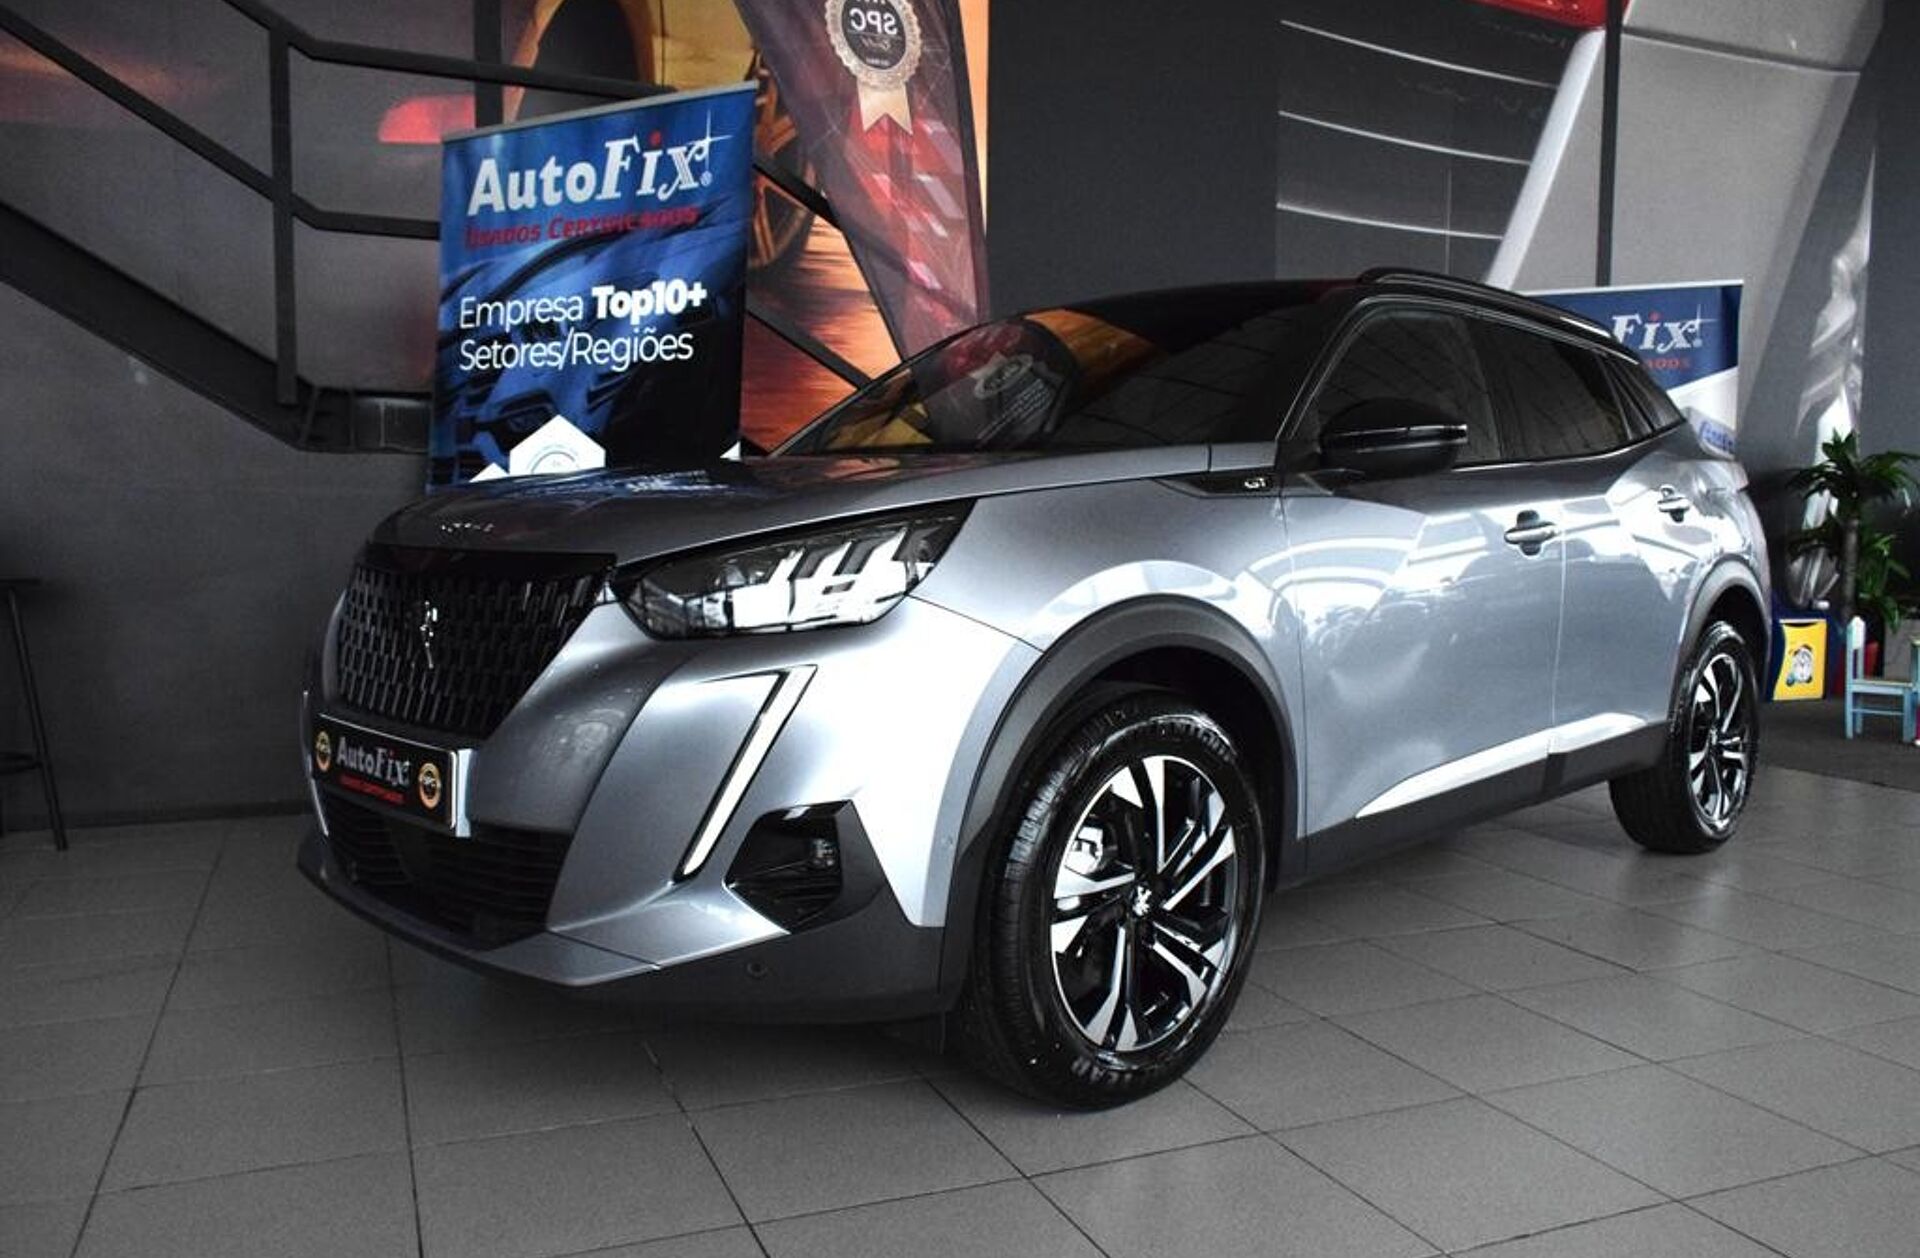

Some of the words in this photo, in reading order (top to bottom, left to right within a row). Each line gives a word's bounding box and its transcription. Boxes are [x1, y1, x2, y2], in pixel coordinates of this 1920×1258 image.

[459, 295, 583, 332] Empresa
[592, 278, 707, 325] Top10+
[459, 325, 694, 372] Setores/Regiões
